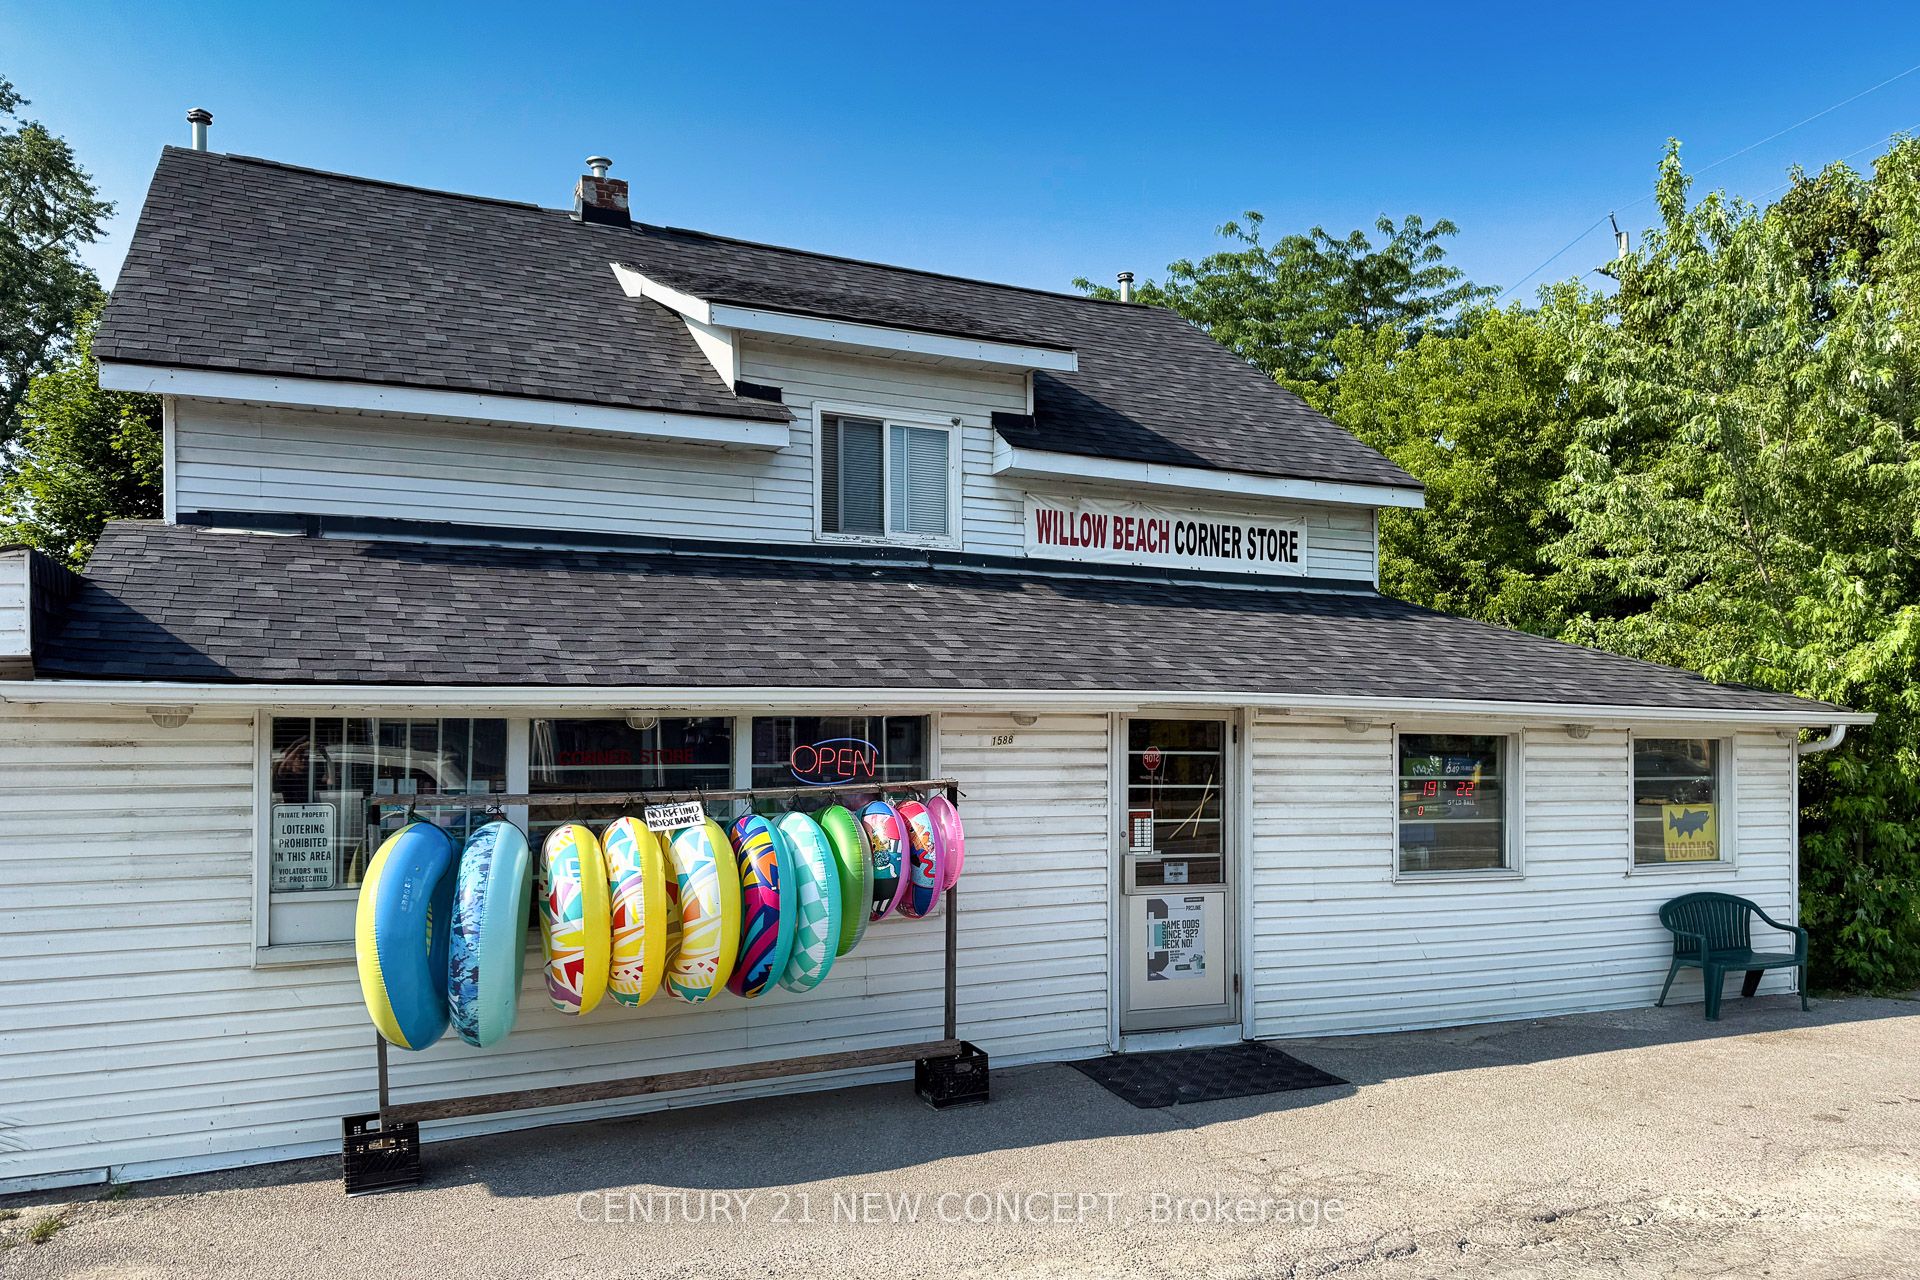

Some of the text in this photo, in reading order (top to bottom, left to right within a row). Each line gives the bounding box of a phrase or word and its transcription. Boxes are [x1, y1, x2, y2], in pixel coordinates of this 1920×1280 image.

[1035, 508, 1299, 563] WILLOW BEACH CORNER STORE
[991, 735, 1014, 747] 1588
[559, 748, 695, 765] CORNER STORE
[791, 745, 876, 777] OPEN
[1423, 781, 1437, 796] 19
[1456, 781, 1475, 796] 22
[647, 805, 700, 818] NO REFUND
[648, 819, 663, 828] NO
[282, 824, 325, 835] LOITERING
[278, 837, 328, 848] PROHIBITED
[1667, 840, 1715, 859] WORMS
[274, 851, 332, 862] IN THIS AREA
[278, 867, 311, 875] VIOLATORS
[289, 875, 328, 883] PROSECUTED
[1161, 919, 1200, 930] SAME ODDS
[1161, 929, 1182, 940] SINCE
[1162, 938, 1193, 949] HECK NO!
